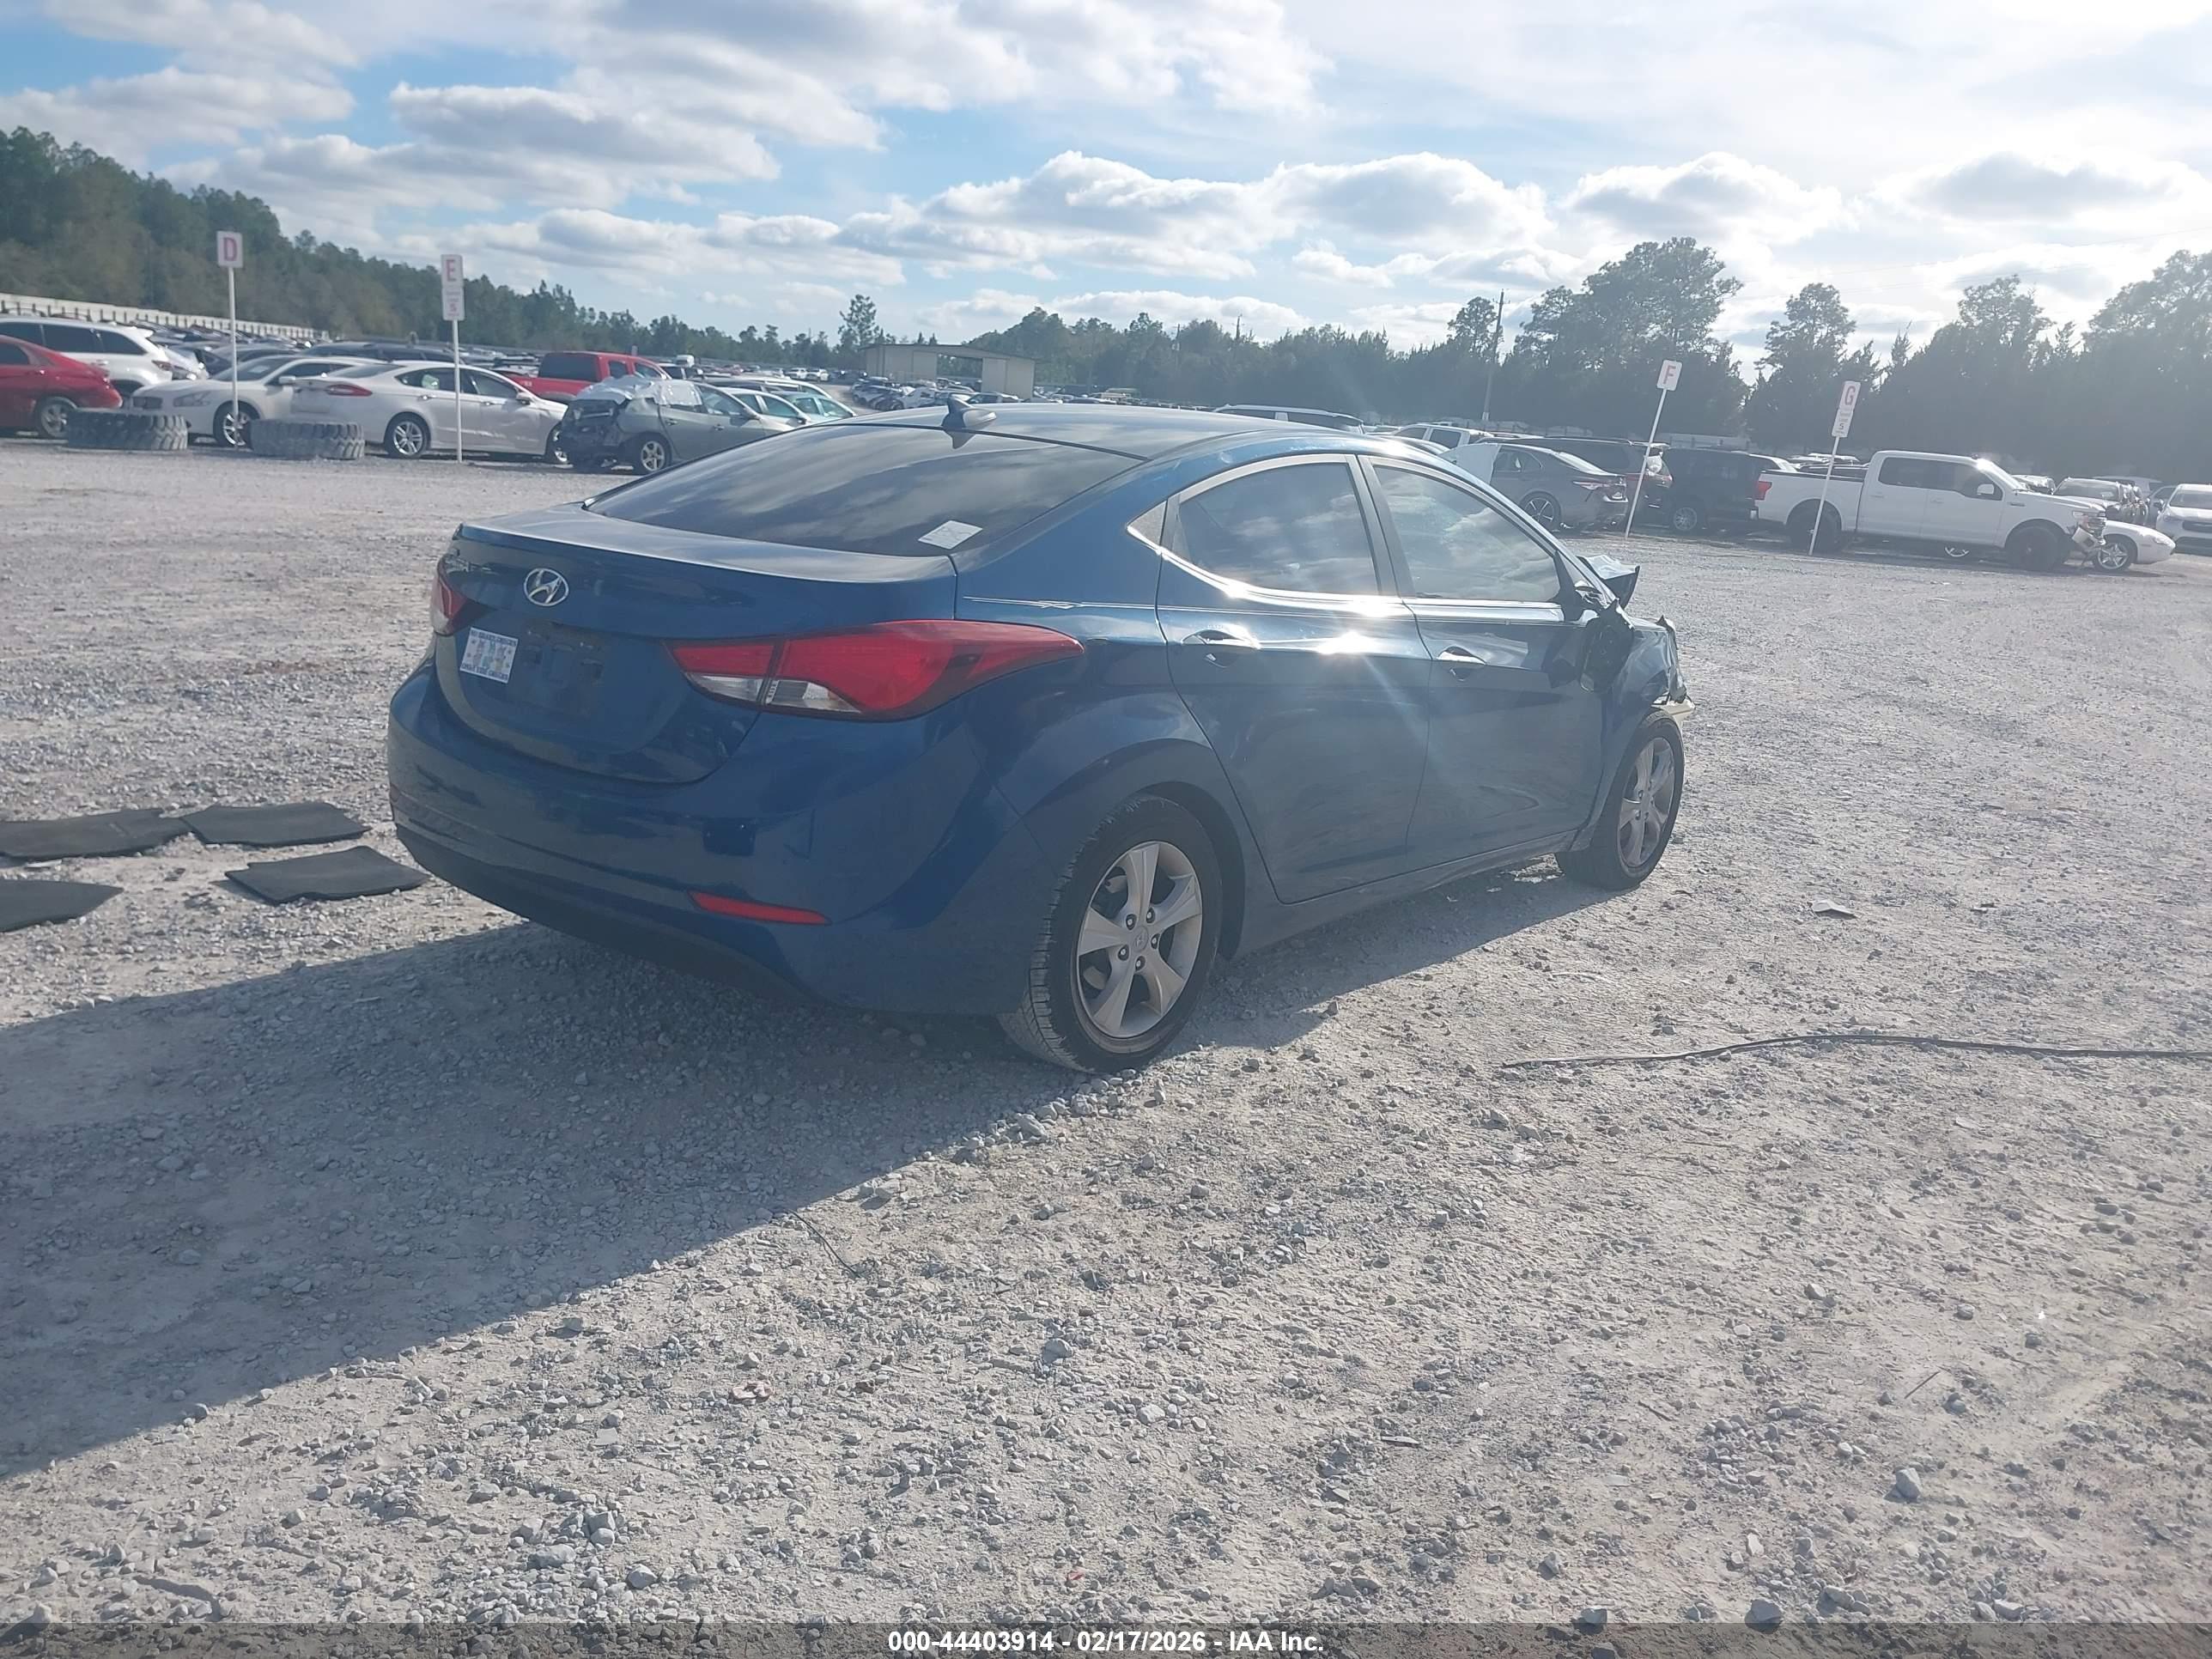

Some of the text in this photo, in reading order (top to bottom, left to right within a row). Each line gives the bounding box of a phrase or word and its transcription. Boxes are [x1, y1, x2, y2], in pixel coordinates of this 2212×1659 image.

[223, 236, 237, 261] D
[446, 258, 457, 282] E
[1662, 365, 1677, 385] F
[1844, 385, 1856, 406] G
